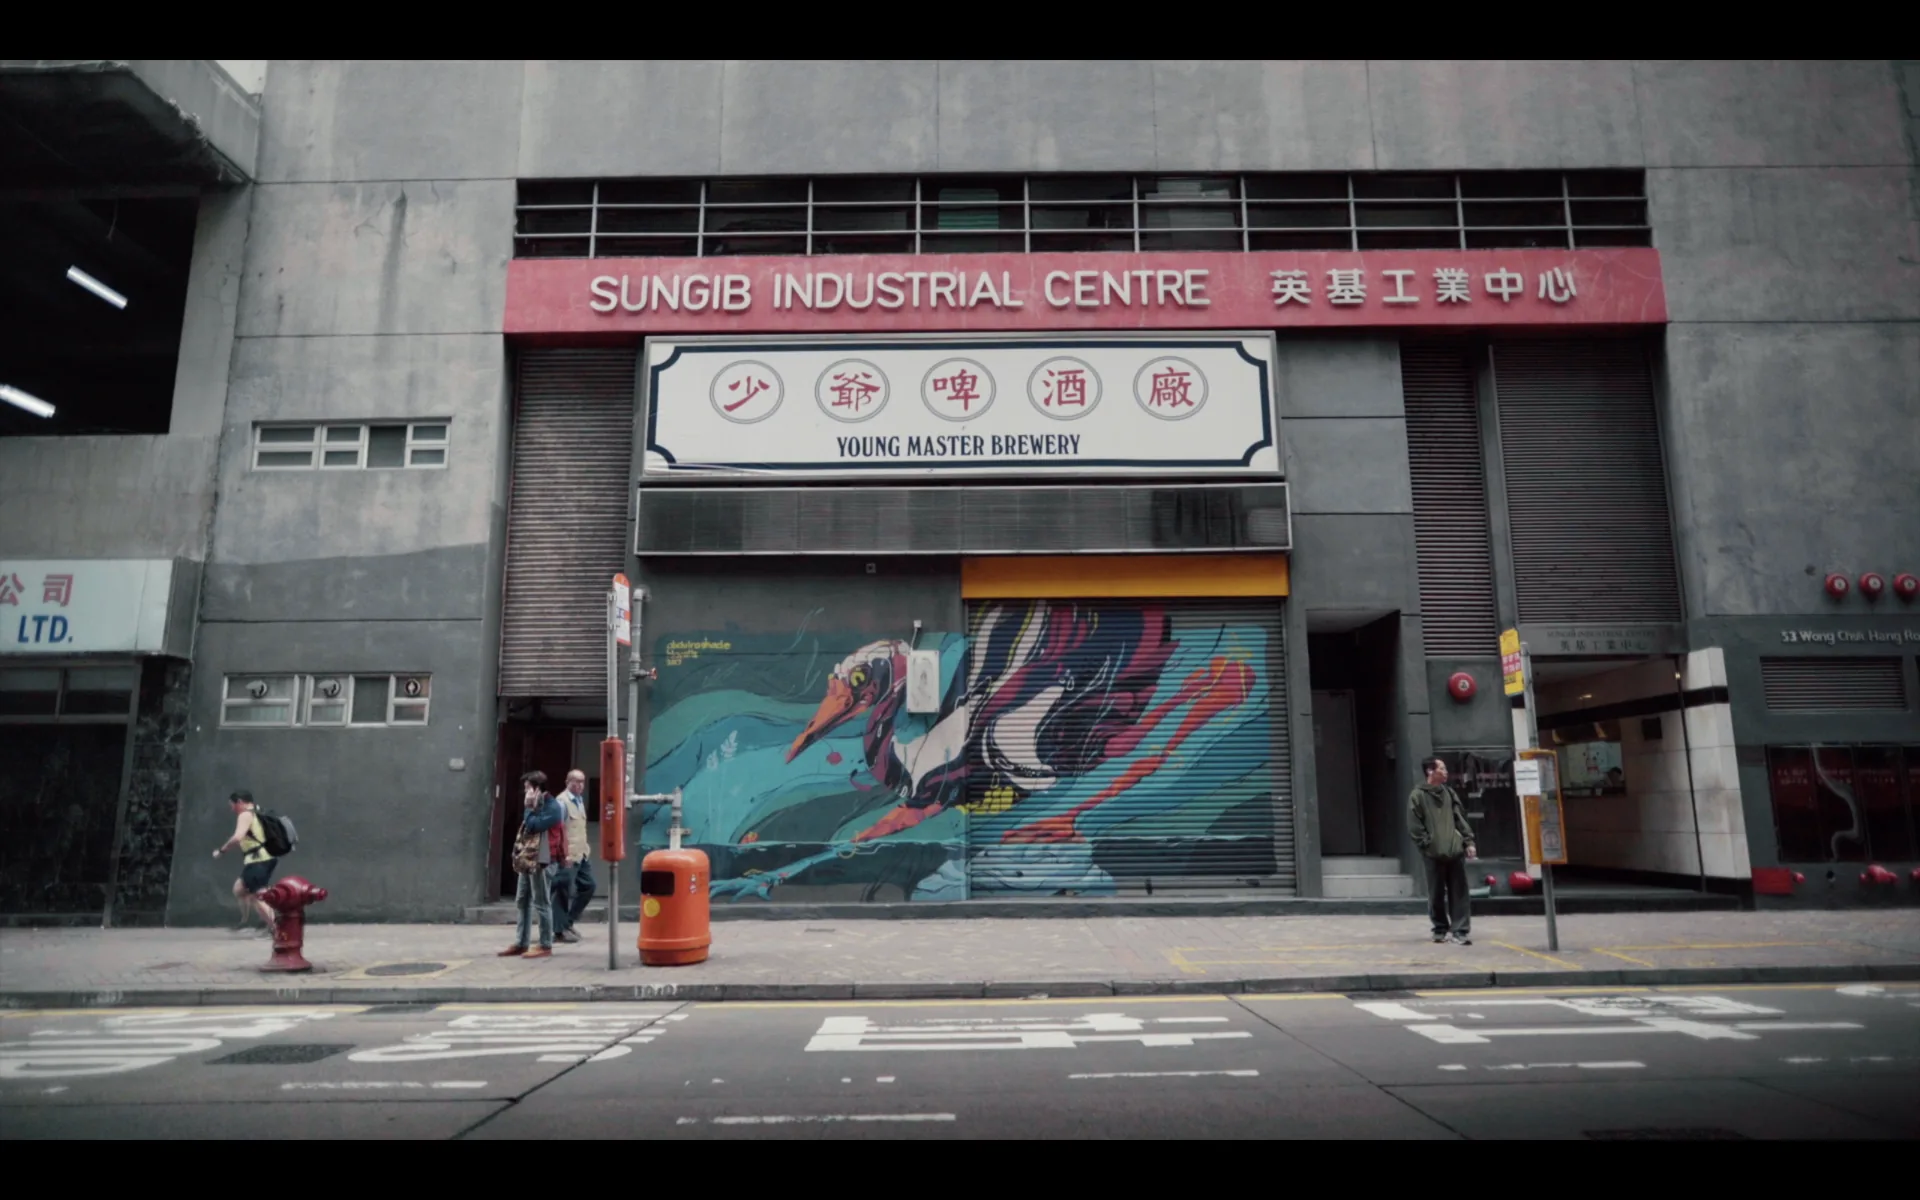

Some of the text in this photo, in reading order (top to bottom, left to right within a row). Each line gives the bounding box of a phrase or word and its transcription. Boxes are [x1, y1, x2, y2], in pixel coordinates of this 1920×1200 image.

[588, 268, 1212, 313] SUNGIB INDUSTRIAL CENTRE
[1270, 267, 1577, 306] 英基工業中心
[722, 365, 1196, 414] 少爺啤酒廠
[836, 433, 1082, 458] YOUNG MASTER BREWERY
[0, 573, 74, 608] 公司
[17, 614, 74, 644] LTD.
[1799, 629, 1836, 645] Wong
[1867, 628, 1902, 645] Hang
